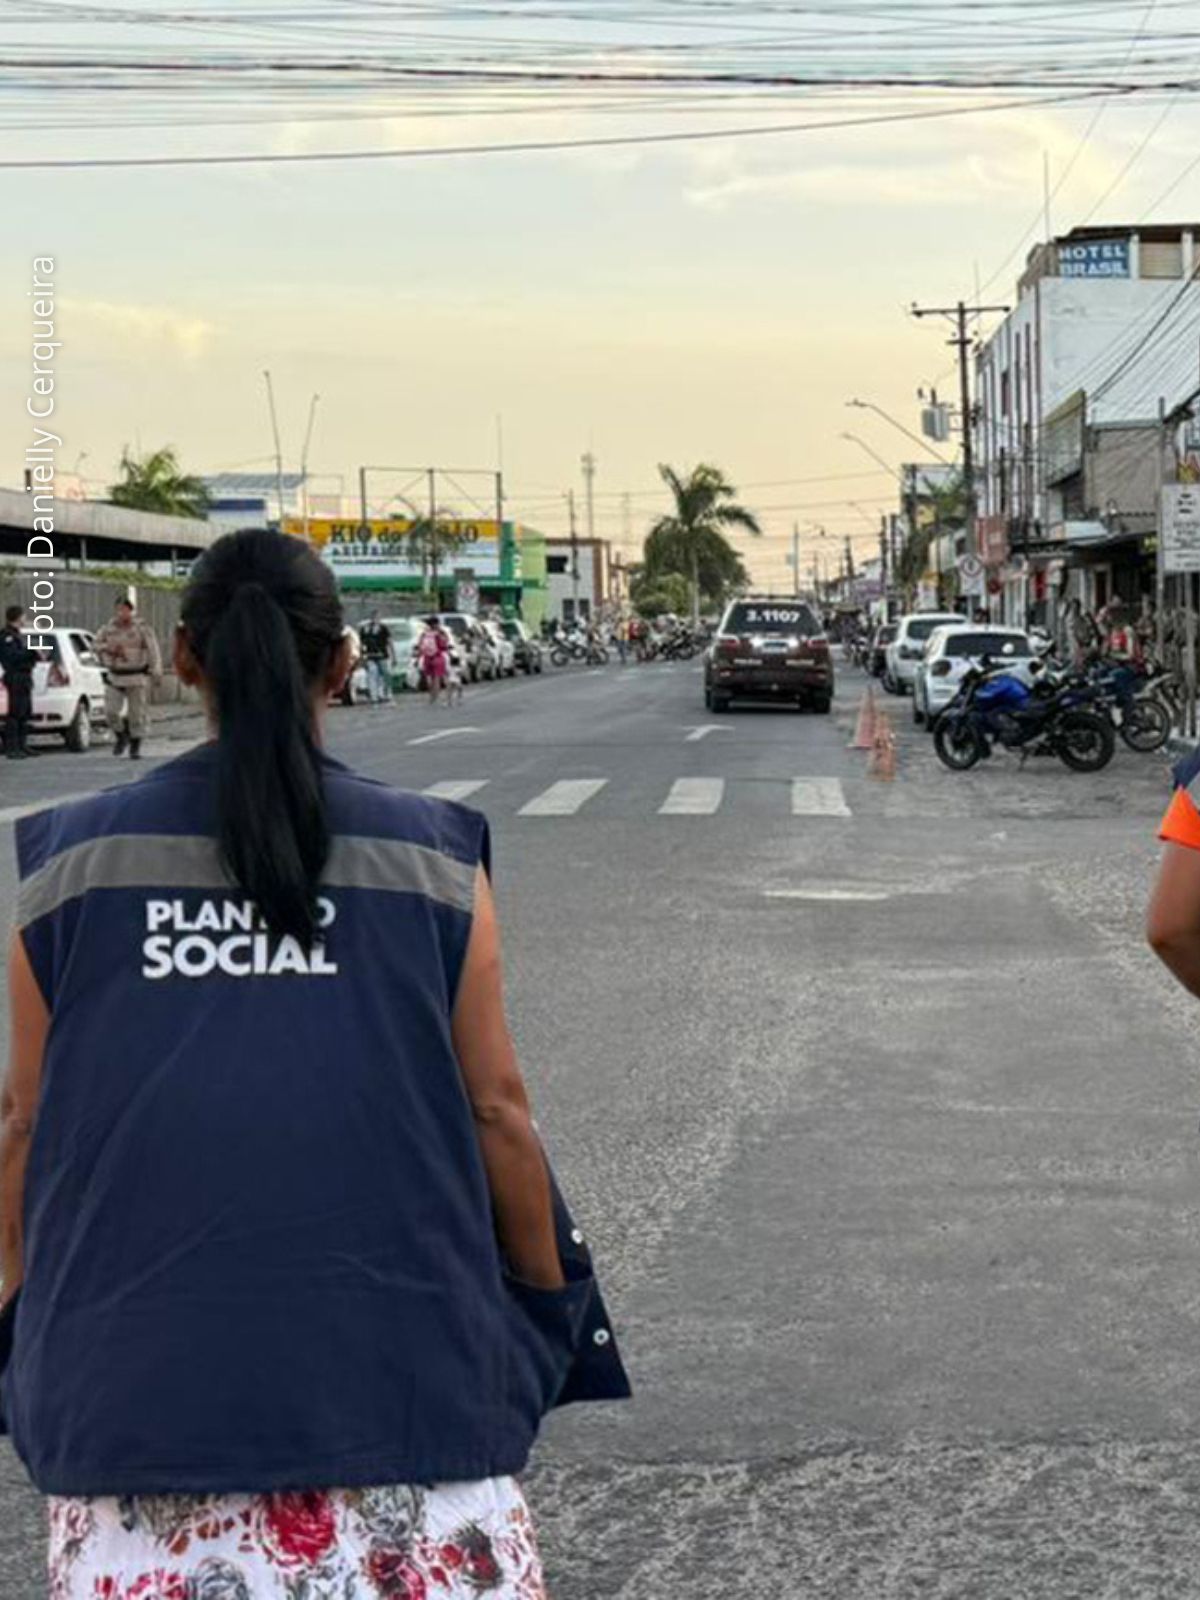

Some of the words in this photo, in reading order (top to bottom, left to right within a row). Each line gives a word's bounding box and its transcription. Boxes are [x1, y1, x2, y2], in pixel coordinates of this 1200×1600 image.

[1058, 244, 1125, 260] HOTEL
[1060, 261, 1128, 275] BRASIL
[746, 608, 800, 622] 3.1107
[146, 896, 337, 932] PLANO
[142, 933, 338, 979] SOCIAL
